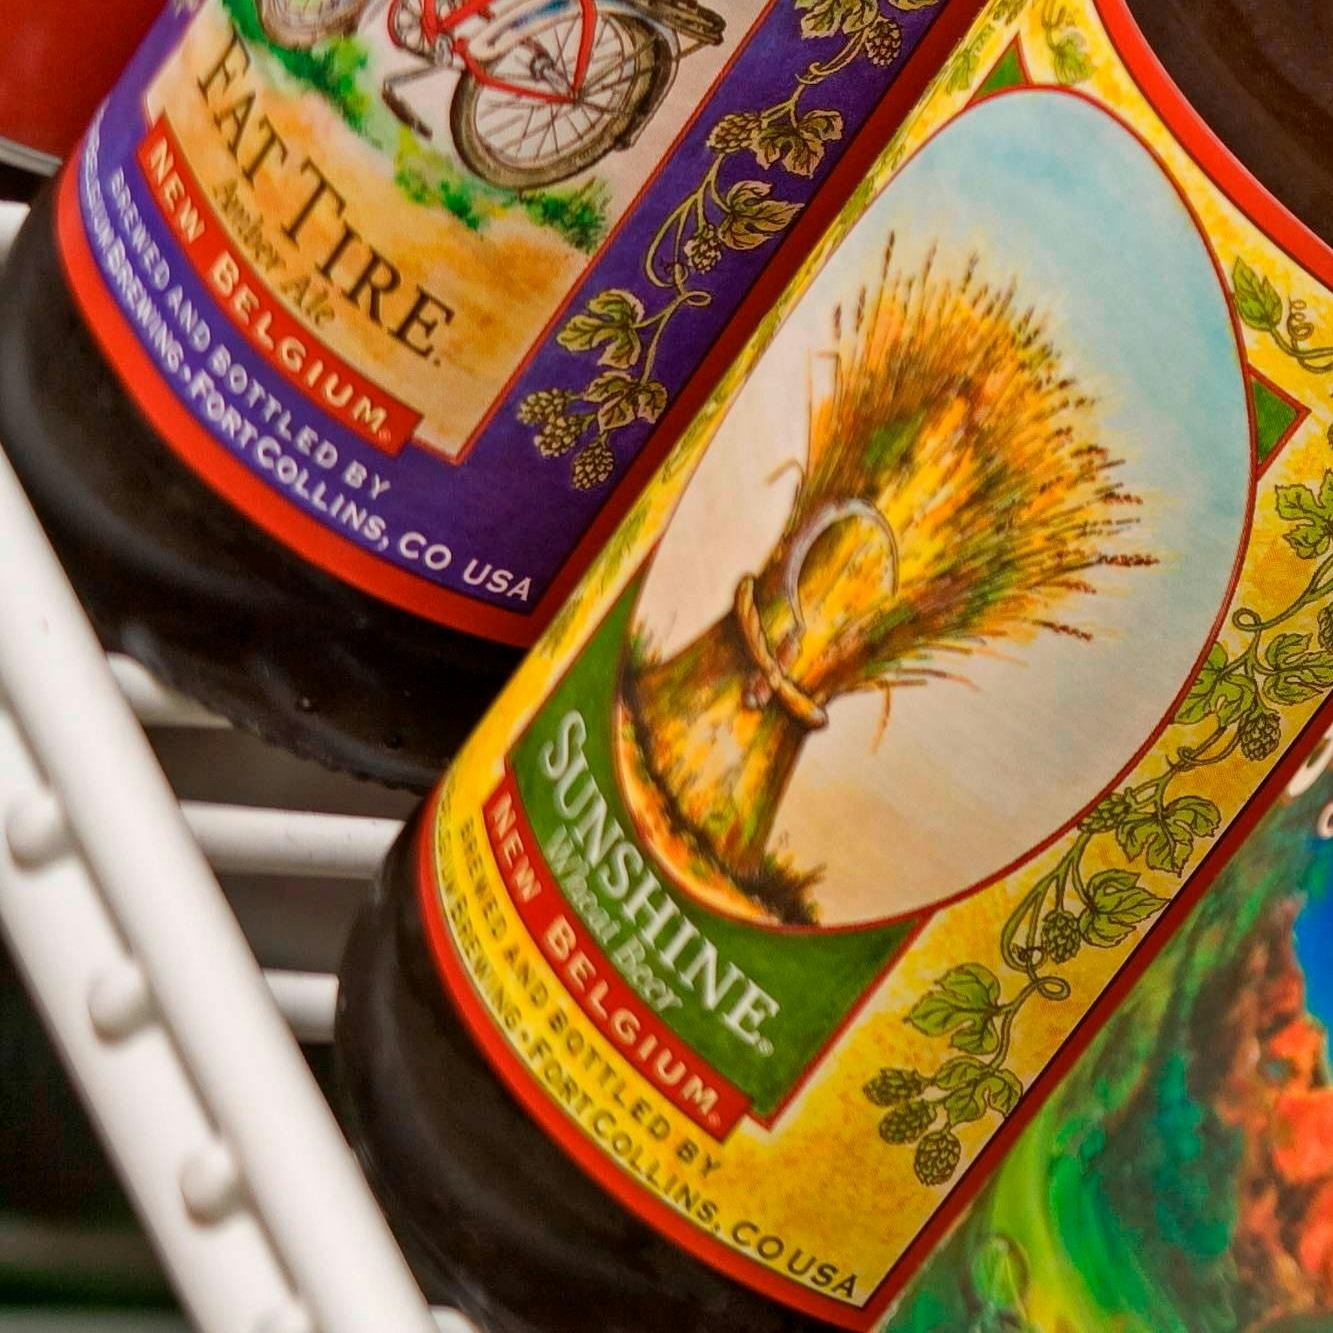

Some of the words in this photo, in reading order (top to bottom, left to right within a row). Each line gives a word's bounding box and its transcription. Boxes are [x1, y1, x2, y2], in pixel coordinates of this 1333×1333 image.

[196, 37, 289, 184] FAT
[110, 165, 170, 292] BREWED
[165, 284, 212, 354] AND
[207, 343, 338, 473] BOTTLED
[344, 460, 392, 502] BY
[150, 136, 206, 244] NEW
[208, 249, 388, 433] BELGIUM
[279, 274, 336, 326] Ale
[397, 532, 453, 572] CO
[461, 562, 534, 603] USA
[489, 791, 543, 904] NEW
[543, 915, 718, 1120] BELGIUM
[538, 709, 781, 1046] SUNSHINE
[503, 941, 550, 1012] AND
[547, 1000, 669, 1141] BOTTLED
[674, 1128, 722, 1180] BY
[731, 1218, 785, 1262] CO
[782, 1245, 857, 1300] USA
